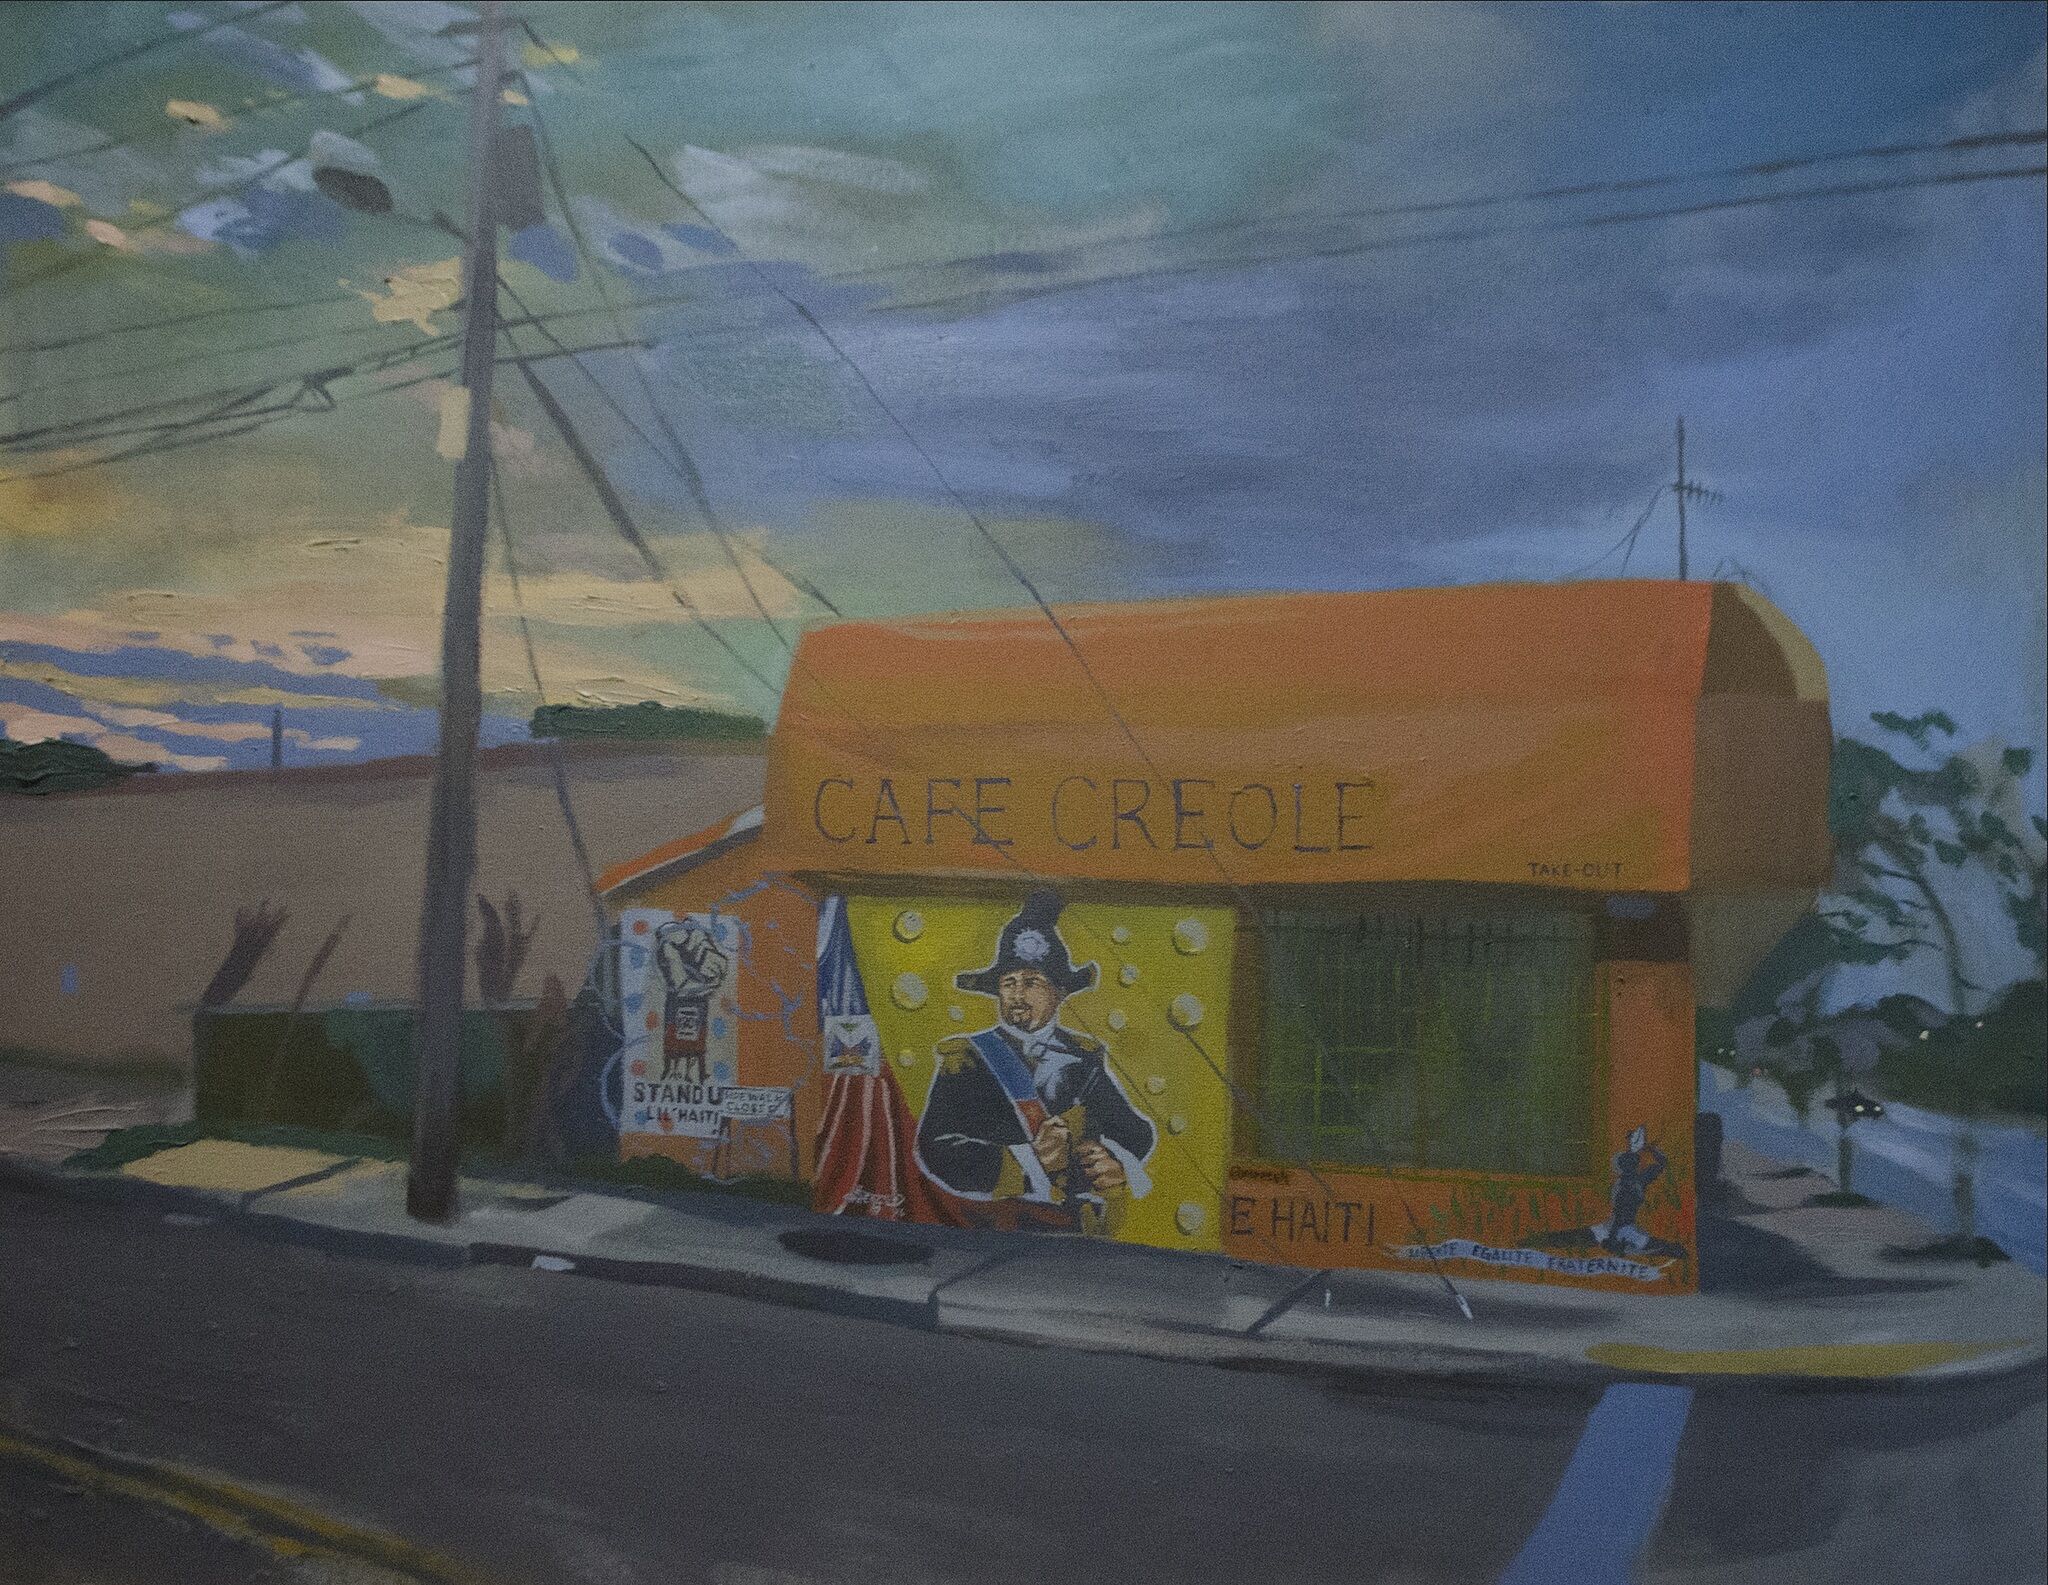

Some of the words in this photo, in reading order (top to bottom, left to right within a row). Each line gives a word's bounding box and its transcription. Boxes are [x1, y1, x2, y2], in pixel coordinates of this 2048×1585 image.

[813, 776, 1014, 846] CAFE
[1051, 776, 1375, 853] CREOLE
[1528, 862, 1623, 878] TAKE-OUT
[1271, 1198, 1375, 1246] HAITI
[1471, 1245, 1533, 1263] EGALITE
[1547, 1256, 1649, 1278] FRATERNITE
